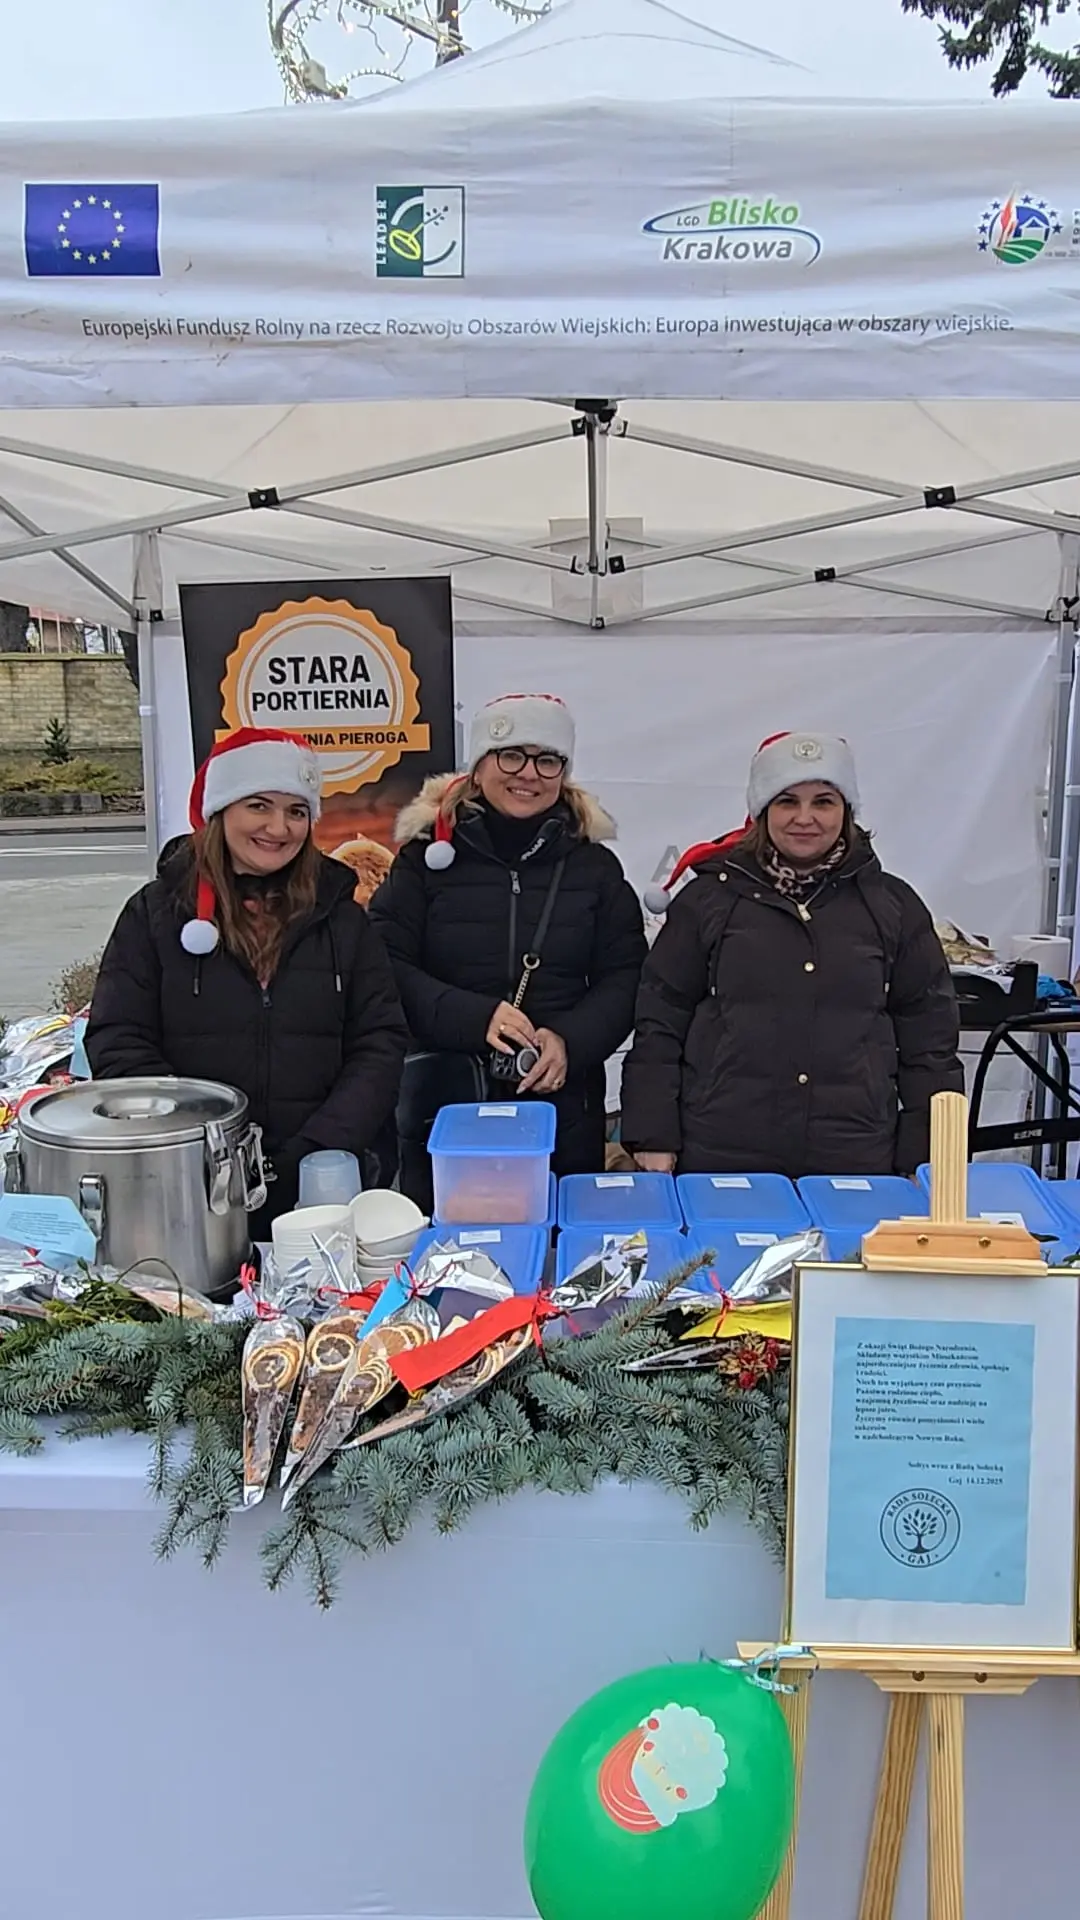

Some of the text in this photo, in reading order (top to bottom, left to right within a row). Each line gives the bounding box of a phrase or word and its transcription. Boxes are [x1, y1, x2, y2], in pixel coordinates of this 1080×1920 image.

[676, 198, 799, 227] LGD Blisko
[376, 199, 388, 265] LEADER
[663, 235, 793, 260] Krakowa
[82, 314, 1015, 340] Europejski Fundusz Rolny na rzecz Rozwoju Obszarów Wiejskich: Europa inwestująca w obszary wiejskie.
[268, 655, 371, 685] STARA
[252, 688, 390, 712] PORTIERNIA
[303, 731, 409, 746] NIA PIEROGA
[886, 1495, 910, 1518] RADA
[907, 1553, 932, 1565] GAJ
